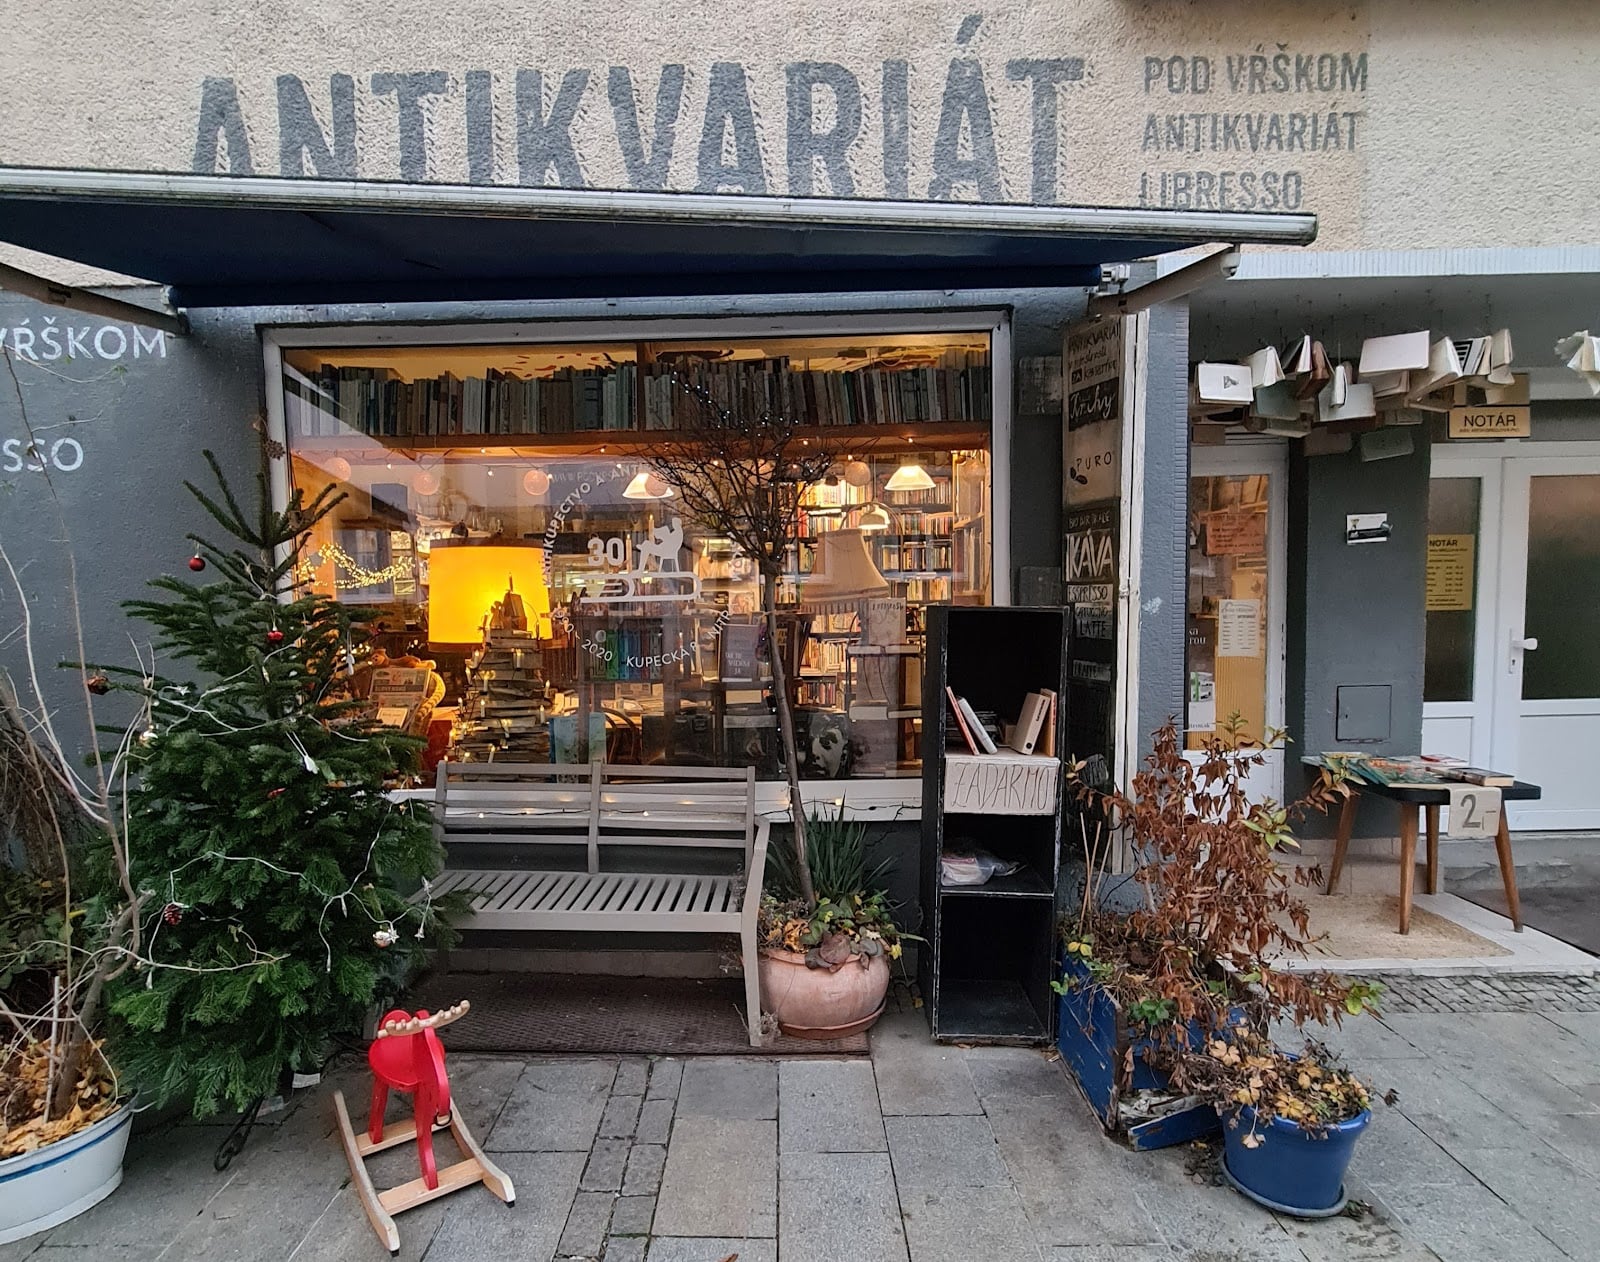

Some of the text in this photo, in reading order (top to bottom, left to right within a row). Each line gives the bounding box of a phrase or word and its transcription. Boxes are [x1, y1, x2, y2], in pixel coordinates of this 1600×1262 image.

[1143, 42, 1368, 94] POD VŔŠKOM
[193, 14, 1085, 202] ANTIKVARIÁT
[1141, 102, 1366, 152] ANTIKVARIÁT
[1138, 170, 1303, 209] LIBRESSO
[1464, 412, 1516, 427] NOTÁR
[1076, 451, 1112, 472] PURO
[587, 537, 624, 566] 30
[1067, 528, 1113, 580] KÁVA
[1081, 620, 1106, 638] LATTE
[581, 639, 613, 662] 2020
[951, 762, 1050, 811] ZADARMO
